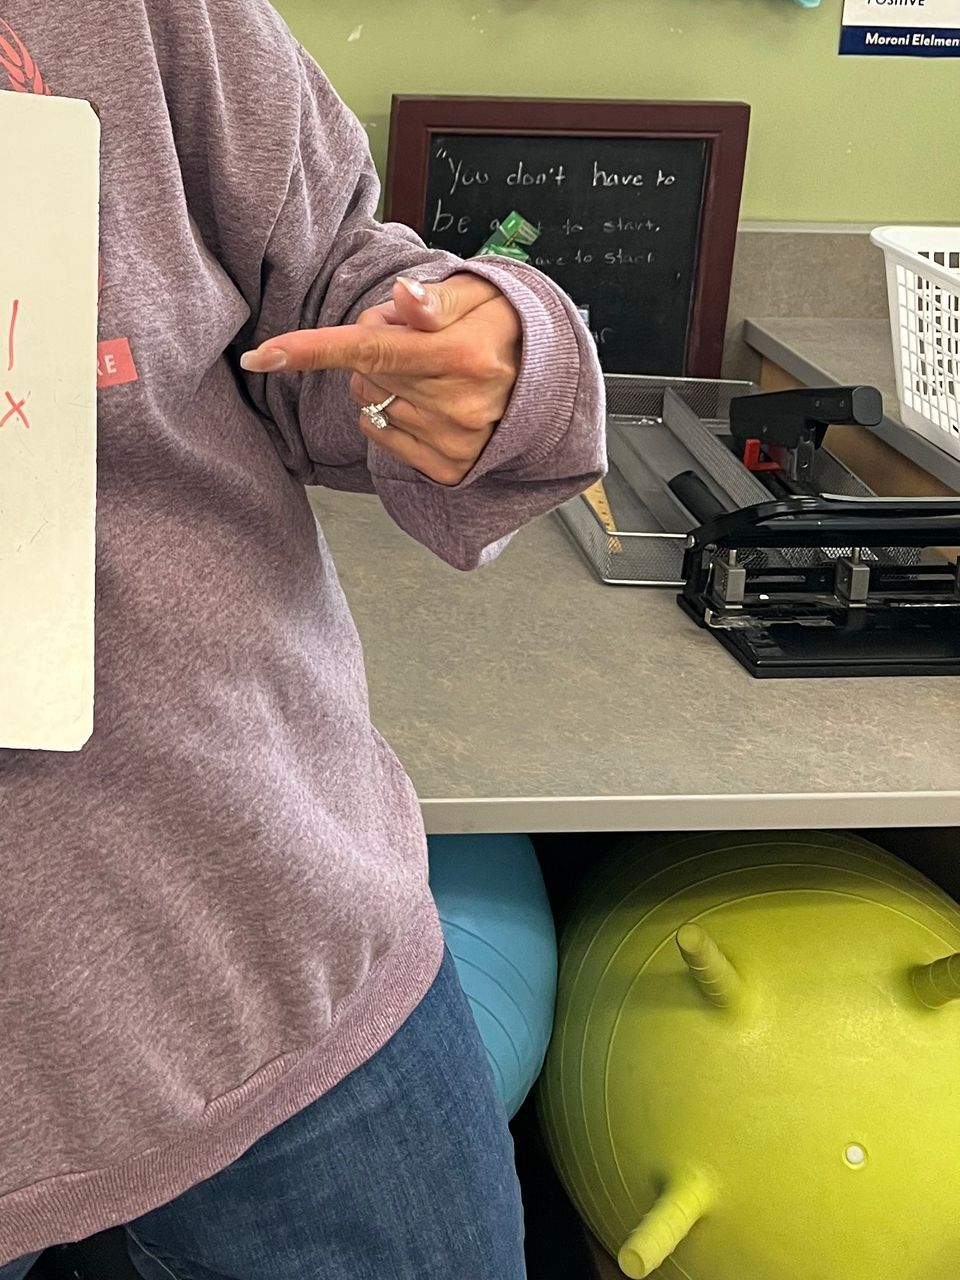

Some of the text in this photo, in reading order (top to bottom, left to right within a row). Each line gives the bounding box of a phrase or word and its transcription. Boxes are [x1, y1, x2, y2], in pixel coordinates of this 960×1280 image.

[865, 32, 910, 46] Moroni
[506, 161, 566, 186] don't
[592, 161, 644, 187] have
[656, 170, 676, 187] to
[432, 200, 469, 233] be
[562, 218, 584, 235] to
[574, 249, 593, 264] to
